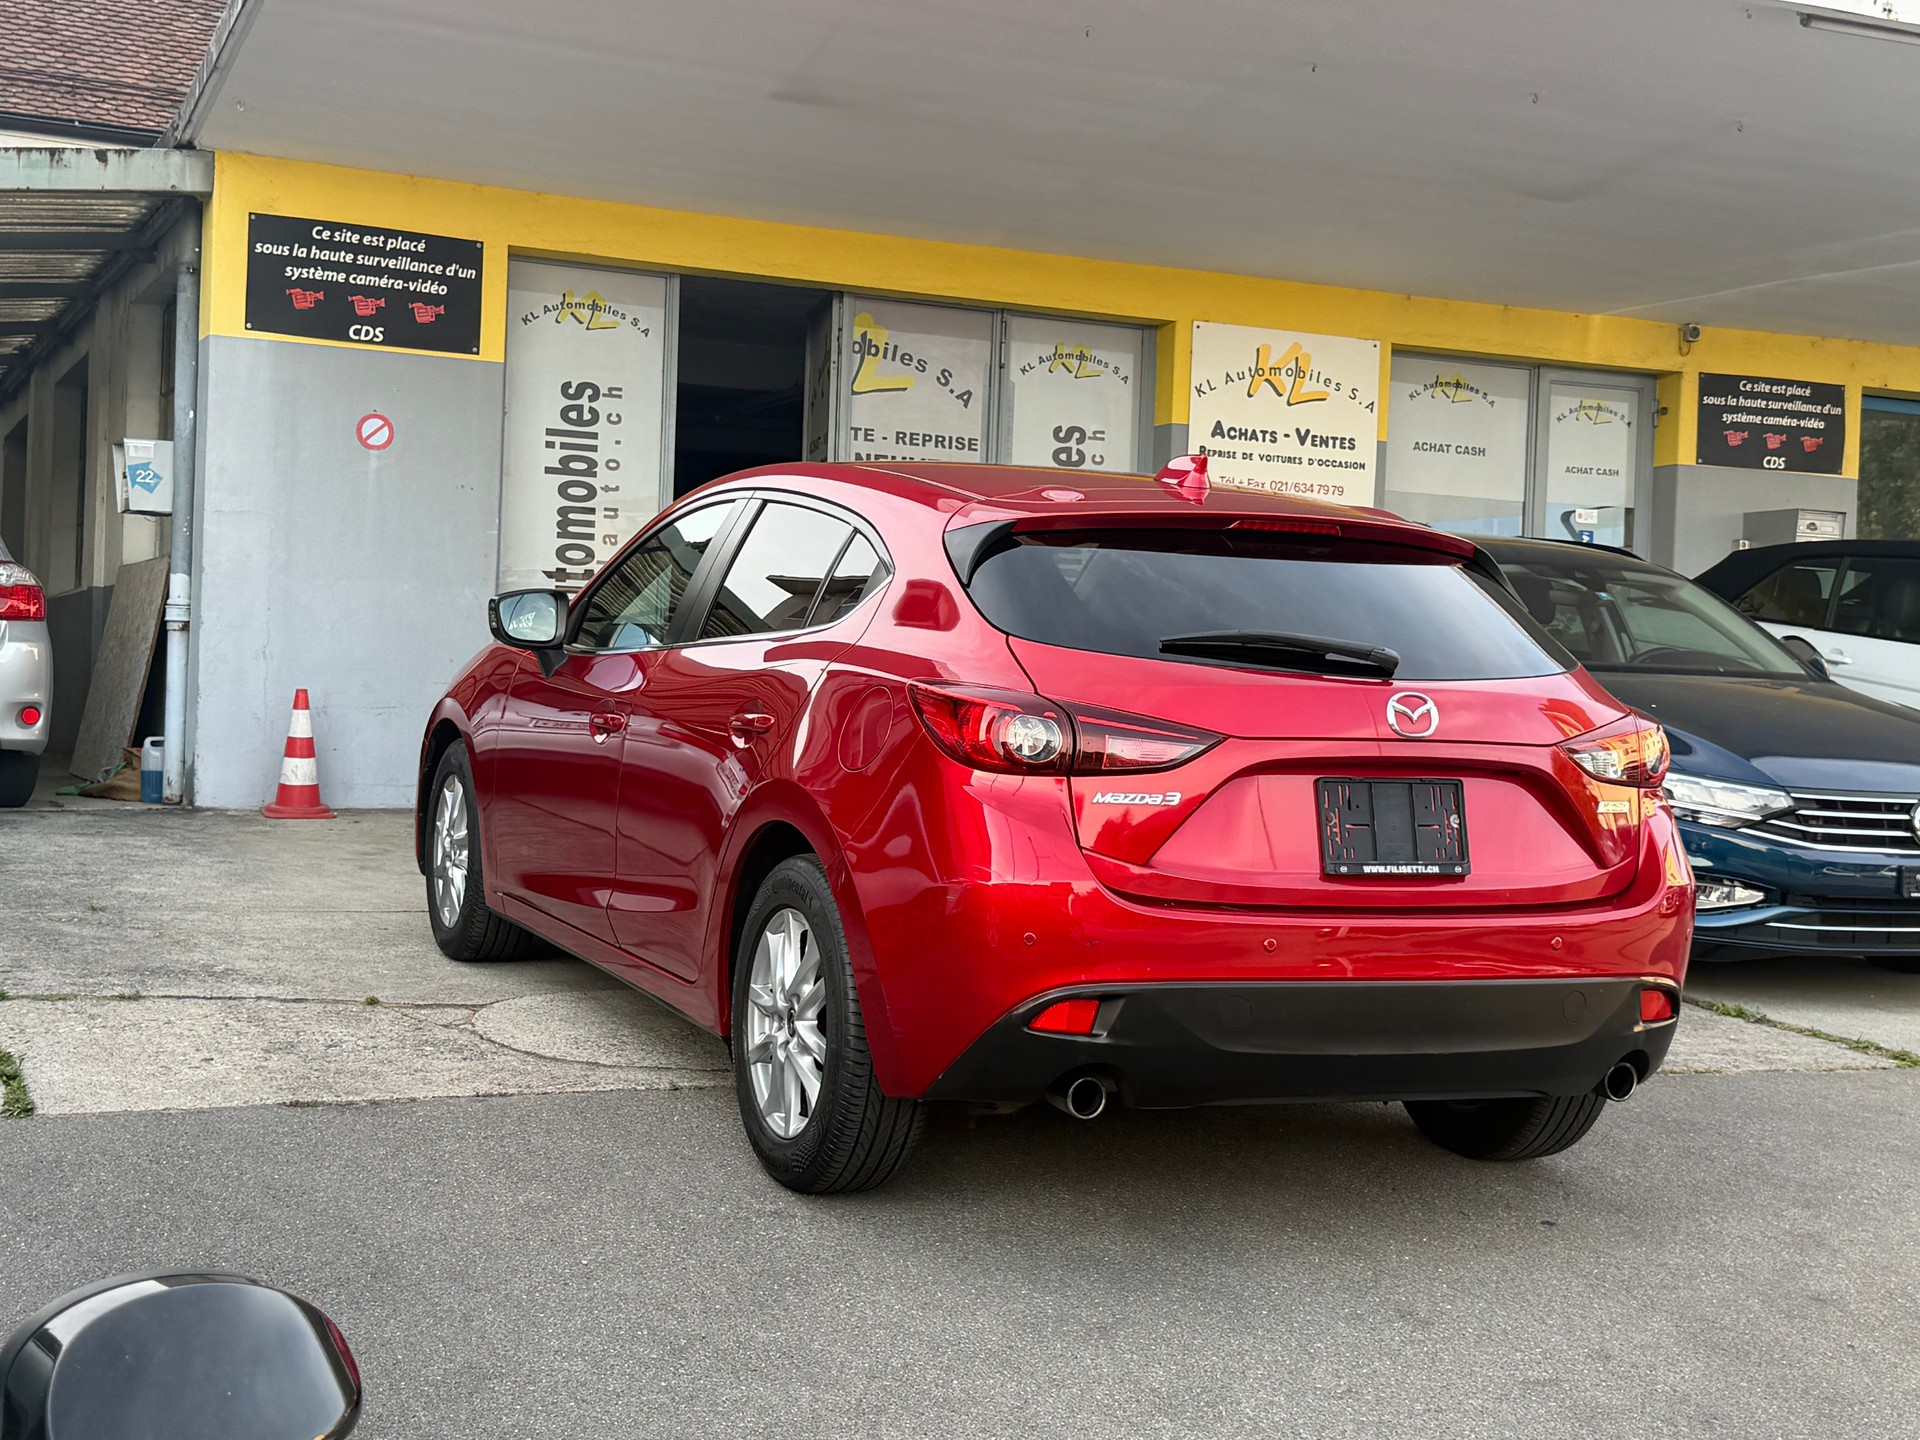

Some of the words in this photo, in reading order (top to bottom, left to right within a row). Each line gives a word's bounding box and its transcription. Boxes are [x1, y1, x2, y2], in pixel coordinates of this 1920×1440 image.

[312, 226, 331, 241] Ce
[333, 228, 360, 245] site
[363, 234, 384, 247] est
[386, 236, 426, 253] placé
[254, 241, 290, 257] sous
[292, 243, 307, 258] la
[310, 245, 354, 264] haute
[356, 252, 443, 276] surveillance
[445, 263, 476, 280] d'un
[284, 265, 346, 284] système
[349, 272, 448, 296] caméra-vidéo
[521, 311, 540, 326] KL
[543, 301, 627, 320] Automobiles
[630, 317, 650, 338] S.A
[349, 324, 385, 343] CDS
[1020, 362, 1035, 376] KL
[1038, 352, 1109, 369] Automobiles
[936, 368, 973, 409] S.A
[1194, 379, 1217, 398] KL
[1225, 366, 1342, 392] Automobiles
[1348, 388, 1375, 414] S.A
[1408, 389, 1421, 401] KL
[1739, 380, 1752, 392] Ce
[1753, 382, 1771, 393] site
[1772, 384, 1786, 394] est
[1786, 385, 1811, 397] placé
[1702, 395, 1726, 406] sous
[1727, 395, 1737, 406] la
[1738, 396, 1766, 409] haute
[1768, 400, 1821, 414] surveillance
[1823, 404, 1842, 415] d'un
[1722, 412, 1761, 425] système
[1763, 415, 1825, 429] caméra-vidéo
[850, 426, 875, 442] TE
[895, 431, 979, 452] REPRISE
[1210, 420, 1278, 444] ACHATS
[1295, 428, 1356, 451] VENTES
[1199, 445, 1237, 460] REPRISE
[1242, 452, 1254, 461] DE
[1258, 453, 1303, 465] VOITURES
[1308, 458, 1366, 471] D'OCCASION
[1413, 441, 1452, 454] ACHAT
[1455, 445, 1486, 457] CASH
[1565, 466, 1594, 476] ACHAT
[1595, 468, 1619, 477] CASH
[1763, 456, 1786, 469] CDS
[135, 470, 154, 483] 22
[1247, 478, 1265, 488] Fax
[1269, 480, 1314, 494] 021/634
